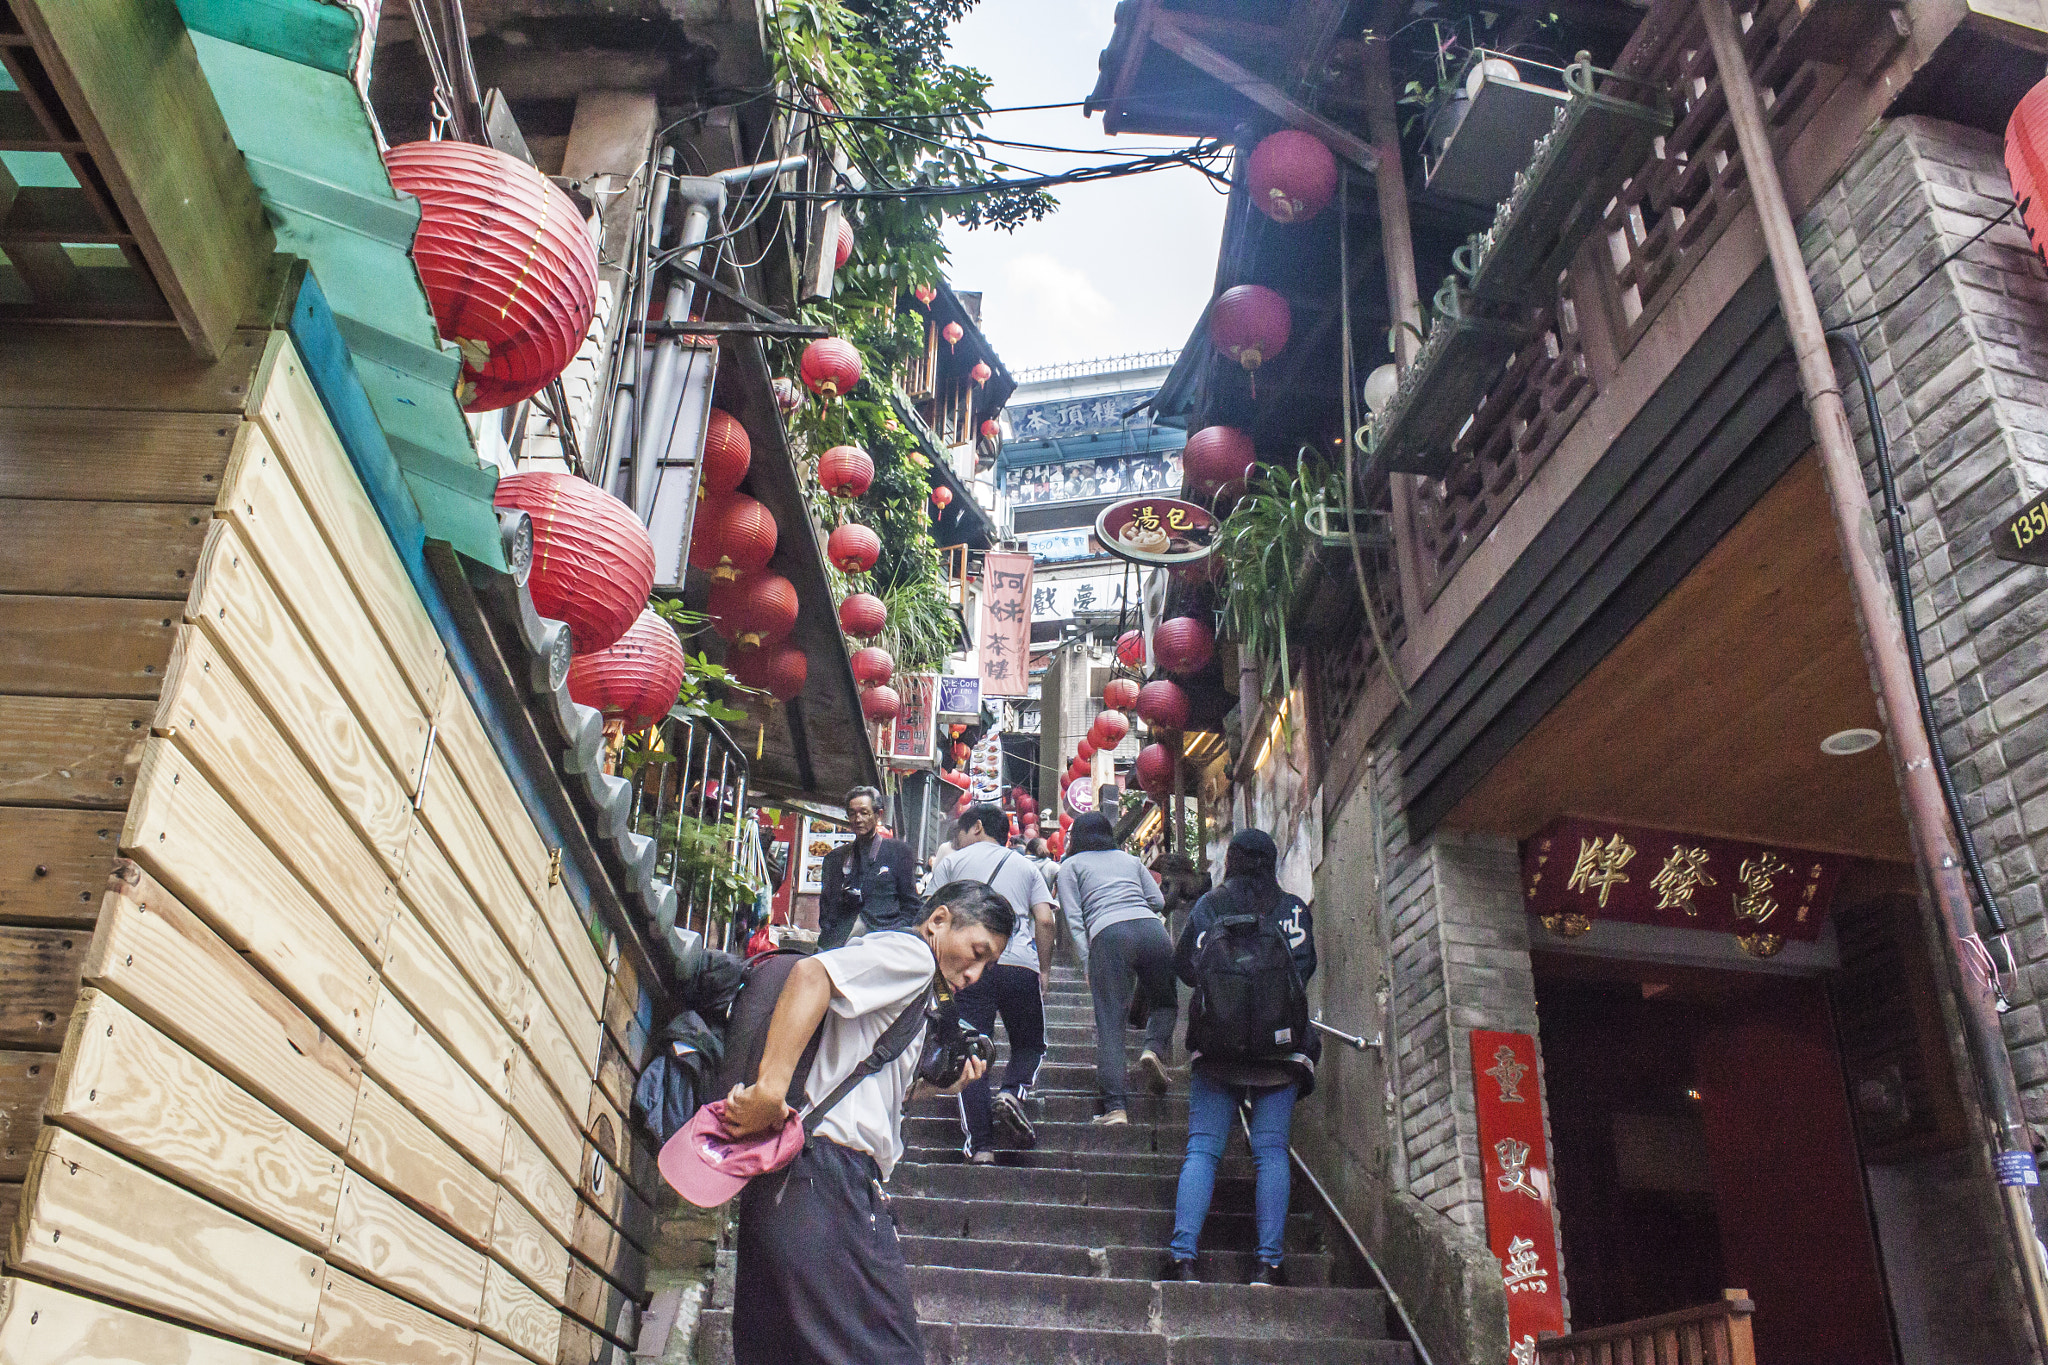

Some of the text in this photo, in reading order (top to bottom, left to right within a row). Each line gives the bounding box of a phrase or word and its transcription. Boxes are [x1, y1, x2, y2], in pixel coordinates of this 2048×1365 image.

[1132, 506, 1194, 531] 湯包
[984, 571, 1026, 680] 阿妹茶樓
